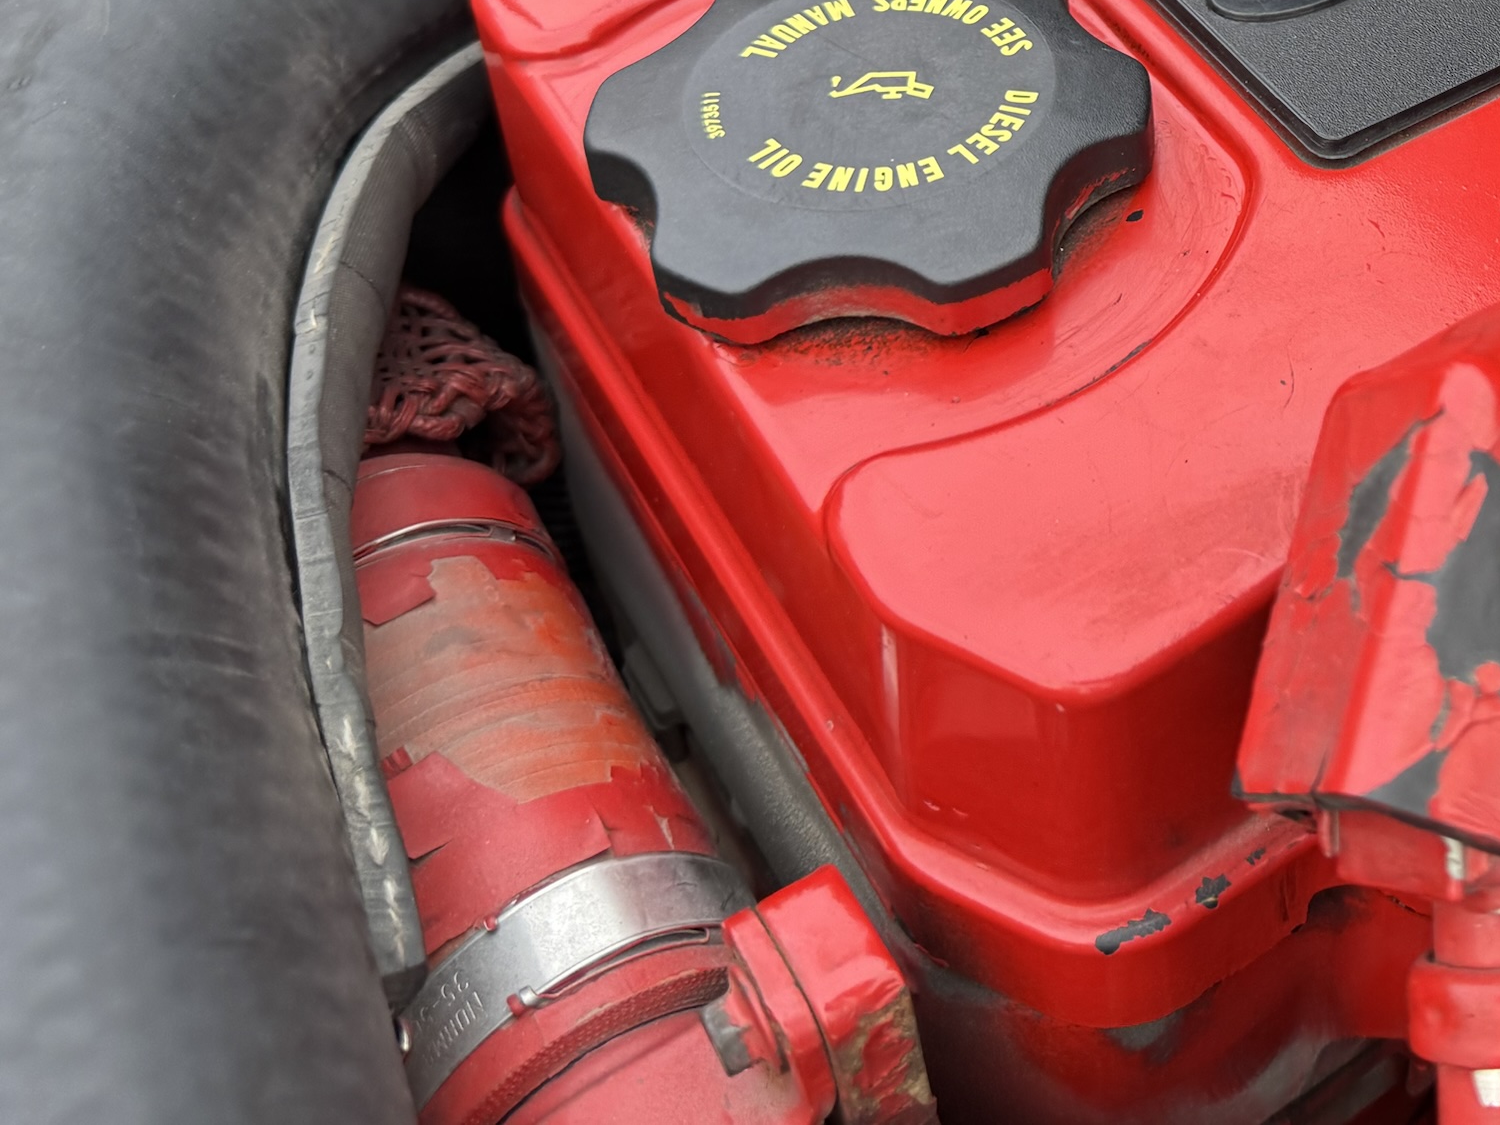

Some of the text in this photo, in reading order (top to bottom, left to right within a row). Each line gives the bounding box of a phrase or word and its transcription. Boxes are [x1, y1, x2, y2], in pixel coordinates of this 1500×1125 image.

[980, 17, 1034, 57] SEE
[701, 92, 726, 139] 3973511
[747, 90, 1039, 193] DIESEL ENGINE OIL
